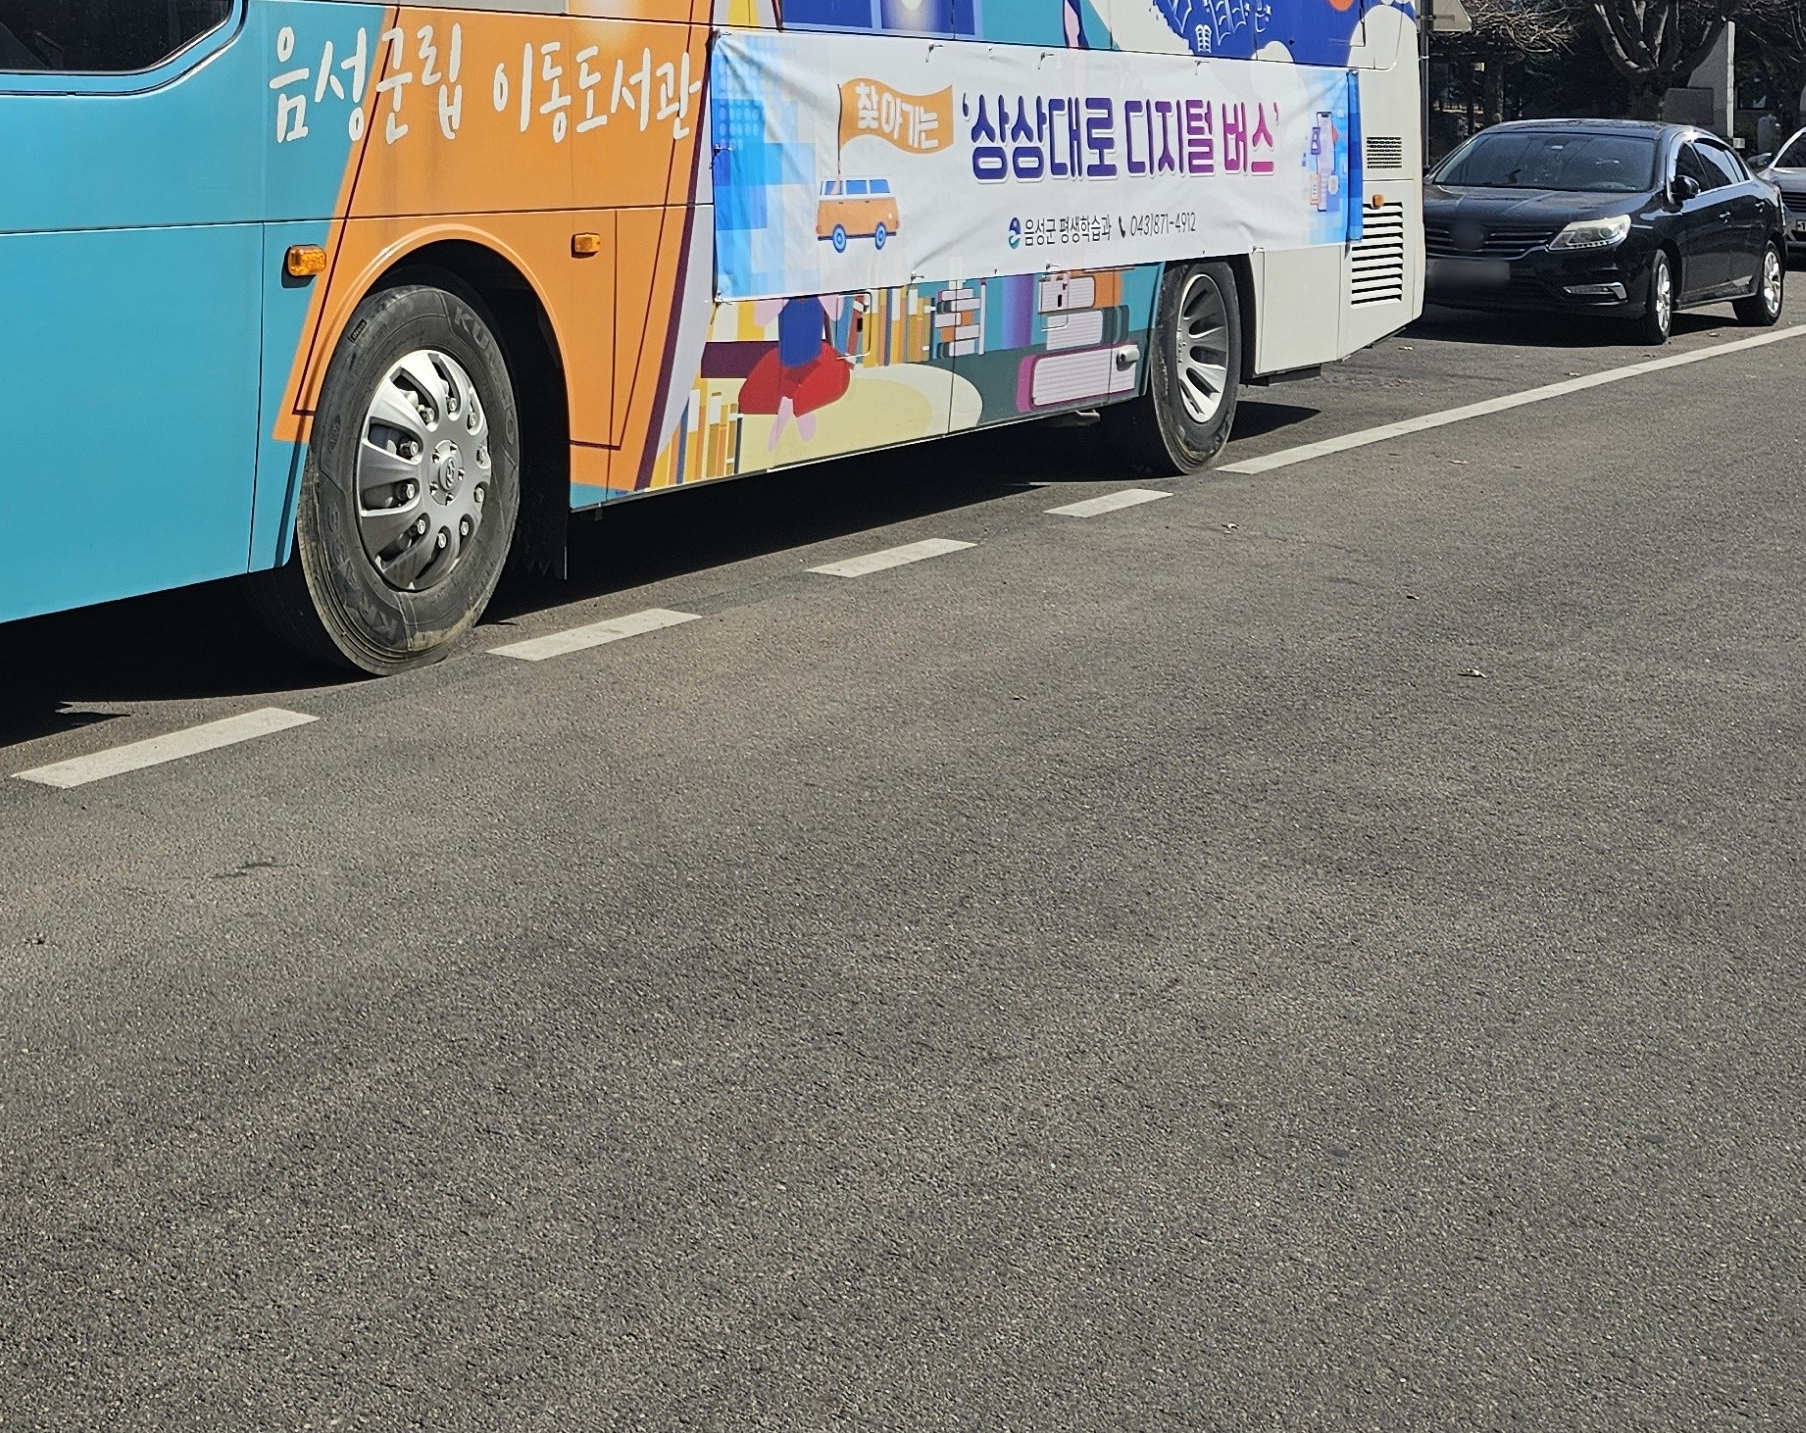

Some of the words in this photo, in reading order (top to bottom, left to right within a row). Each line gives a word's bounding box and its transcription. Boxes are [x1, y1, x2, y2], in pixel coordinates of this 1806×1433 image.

[270, 23, 462, 145] 음성군립
[493, 41, 702, 144] 이동도서관
[855, 83, 939, 150] 찾아가는
[1125, 98, 1215, 176] 디지털
[1024, 217, 1057, 247] 음성군
[1059, 213, 1112, 244] 평생학습과
[1130, 211, 1197, 237] 043)871-4912
